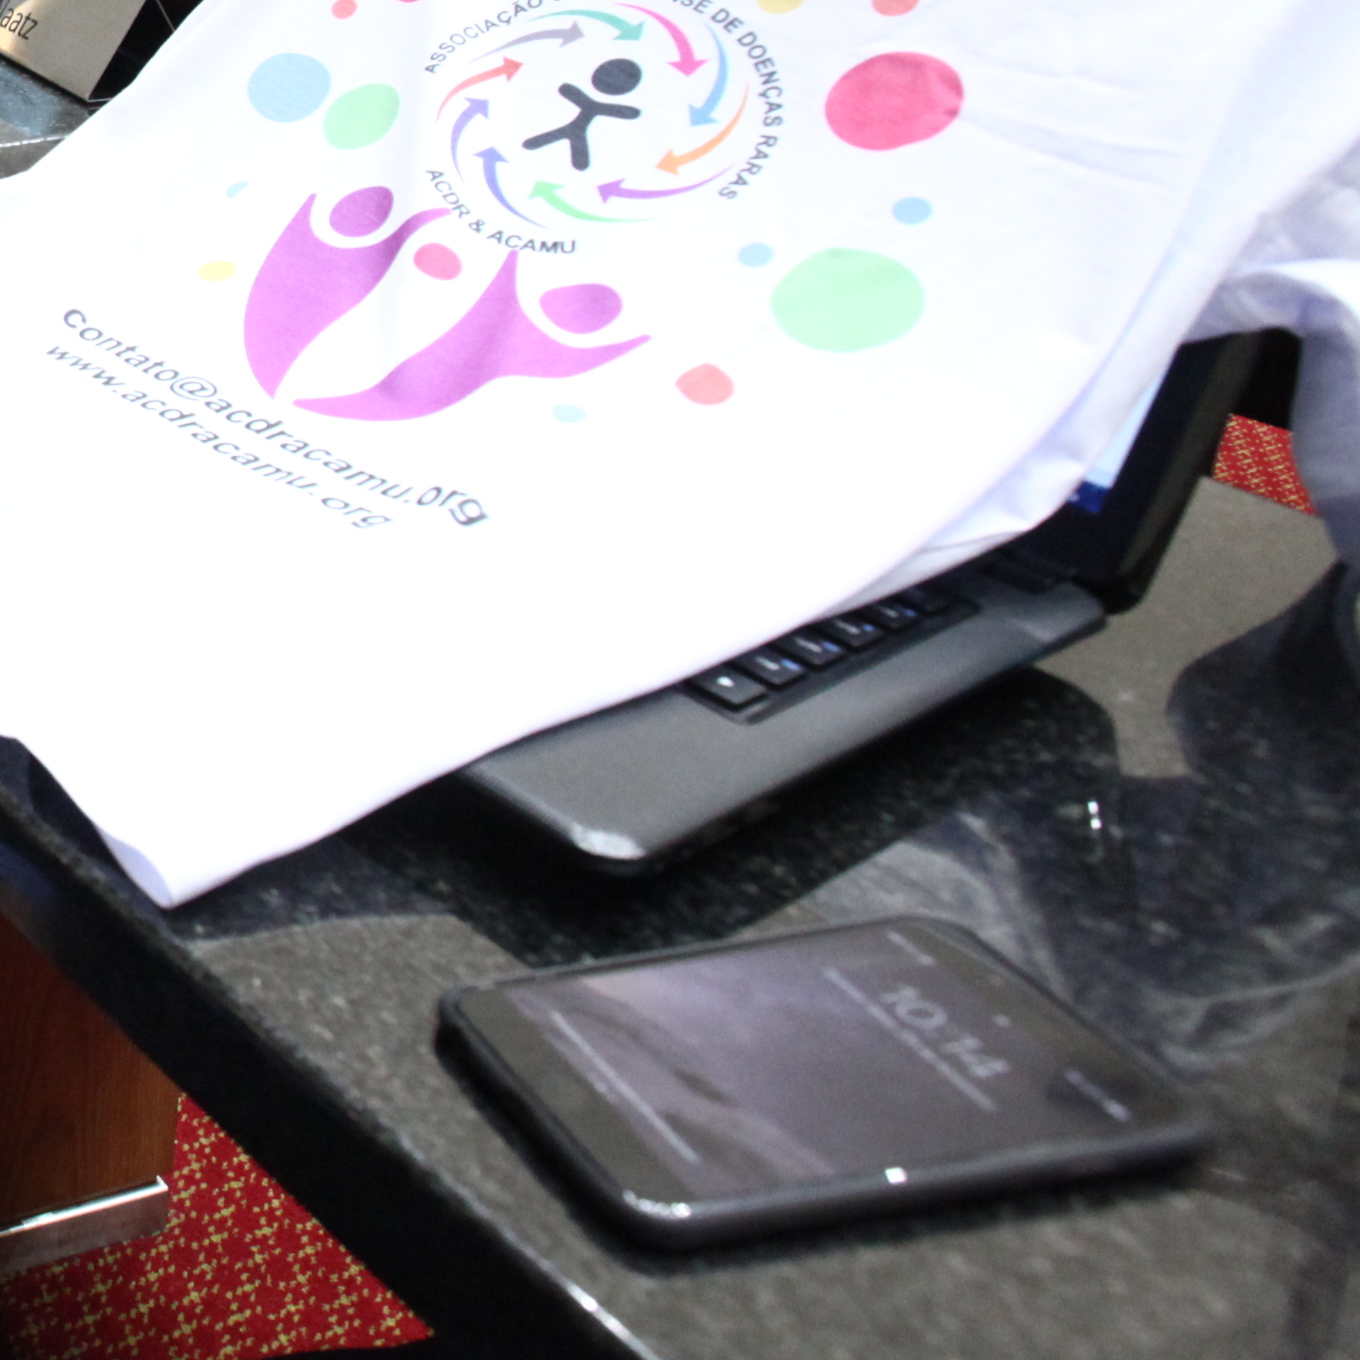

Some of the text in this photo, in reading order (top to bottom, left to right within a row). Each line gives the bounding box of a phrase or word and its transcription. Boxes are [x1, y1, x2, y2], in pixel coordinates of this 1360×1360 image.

[710, 6, 746, 36] DE
[736, 30, 785, 129] DOENÇAS
[718, 133, 780, 200] RARAS
[426, 168, 577, 256] ACDR & ACAMU
[45, 344, 394, 530] www.acdracamu.org
